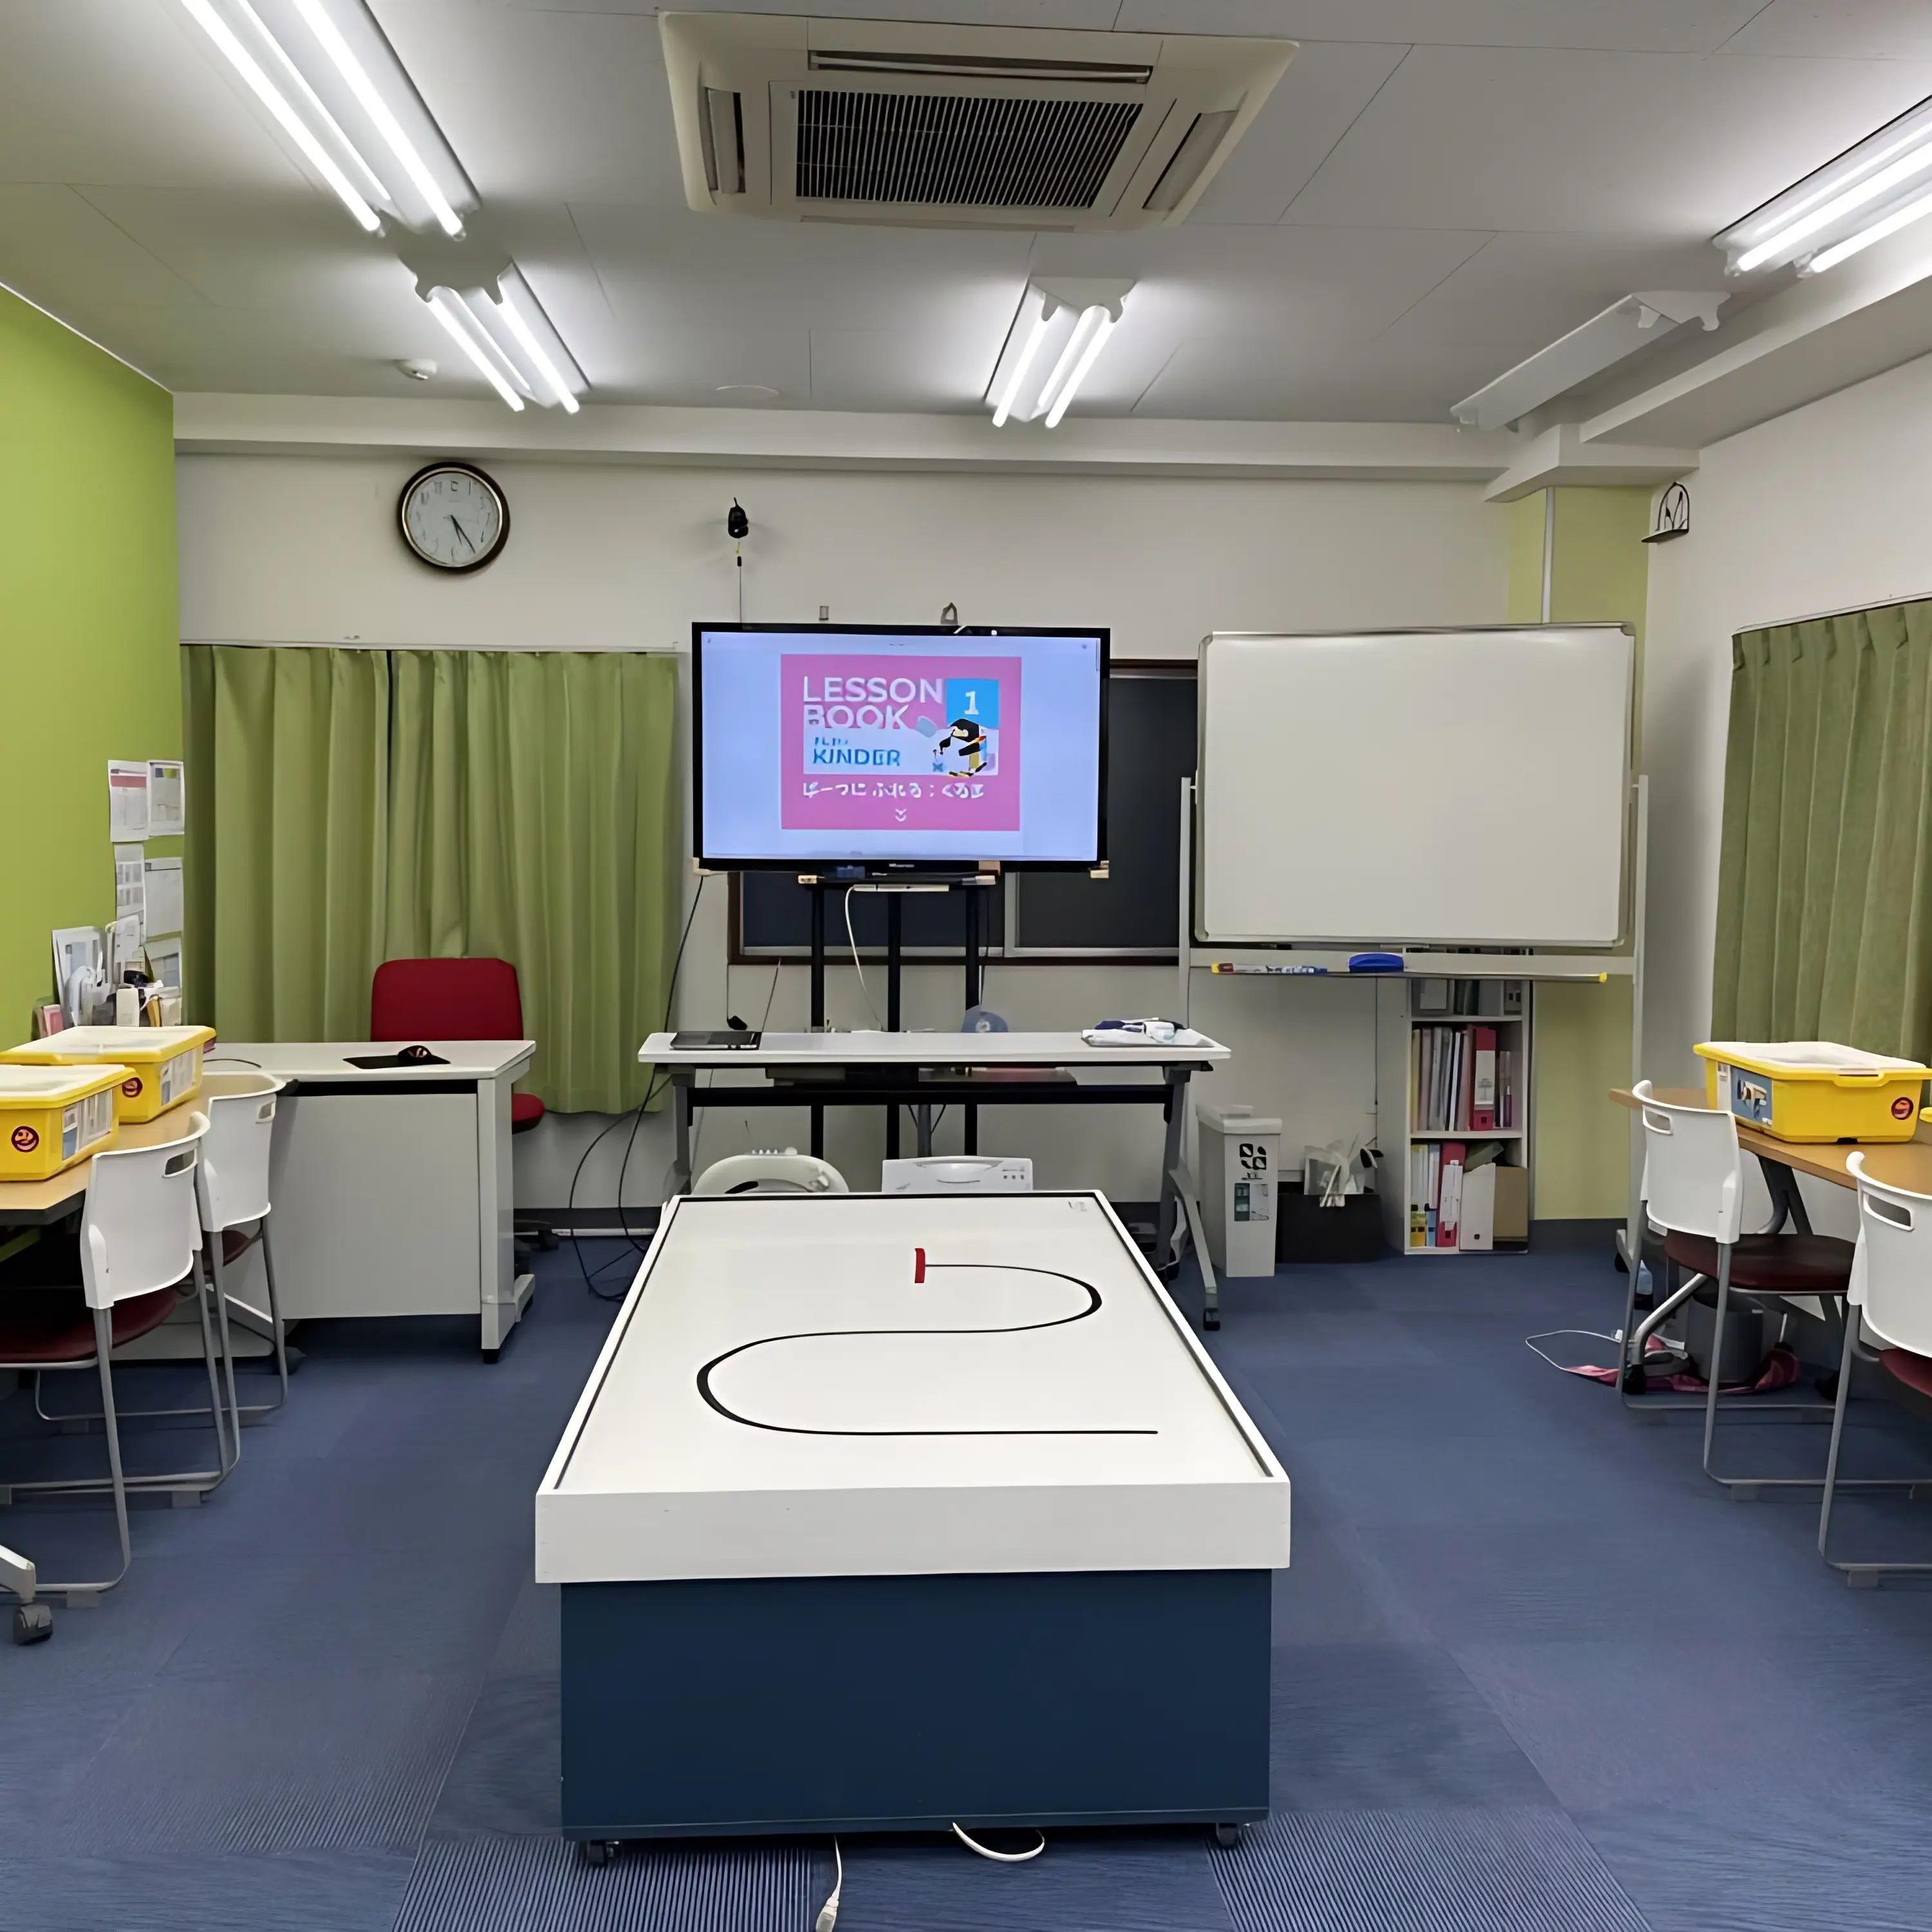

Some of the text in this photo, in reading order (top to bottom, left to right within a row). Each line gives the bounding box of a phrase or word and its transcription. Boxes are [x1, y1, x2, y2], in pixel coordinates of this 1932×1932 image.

[803, 676, 943, 704] LESSON
[964, 690, 980, 715] 1
[803, 704, 909, 730] BOOK
